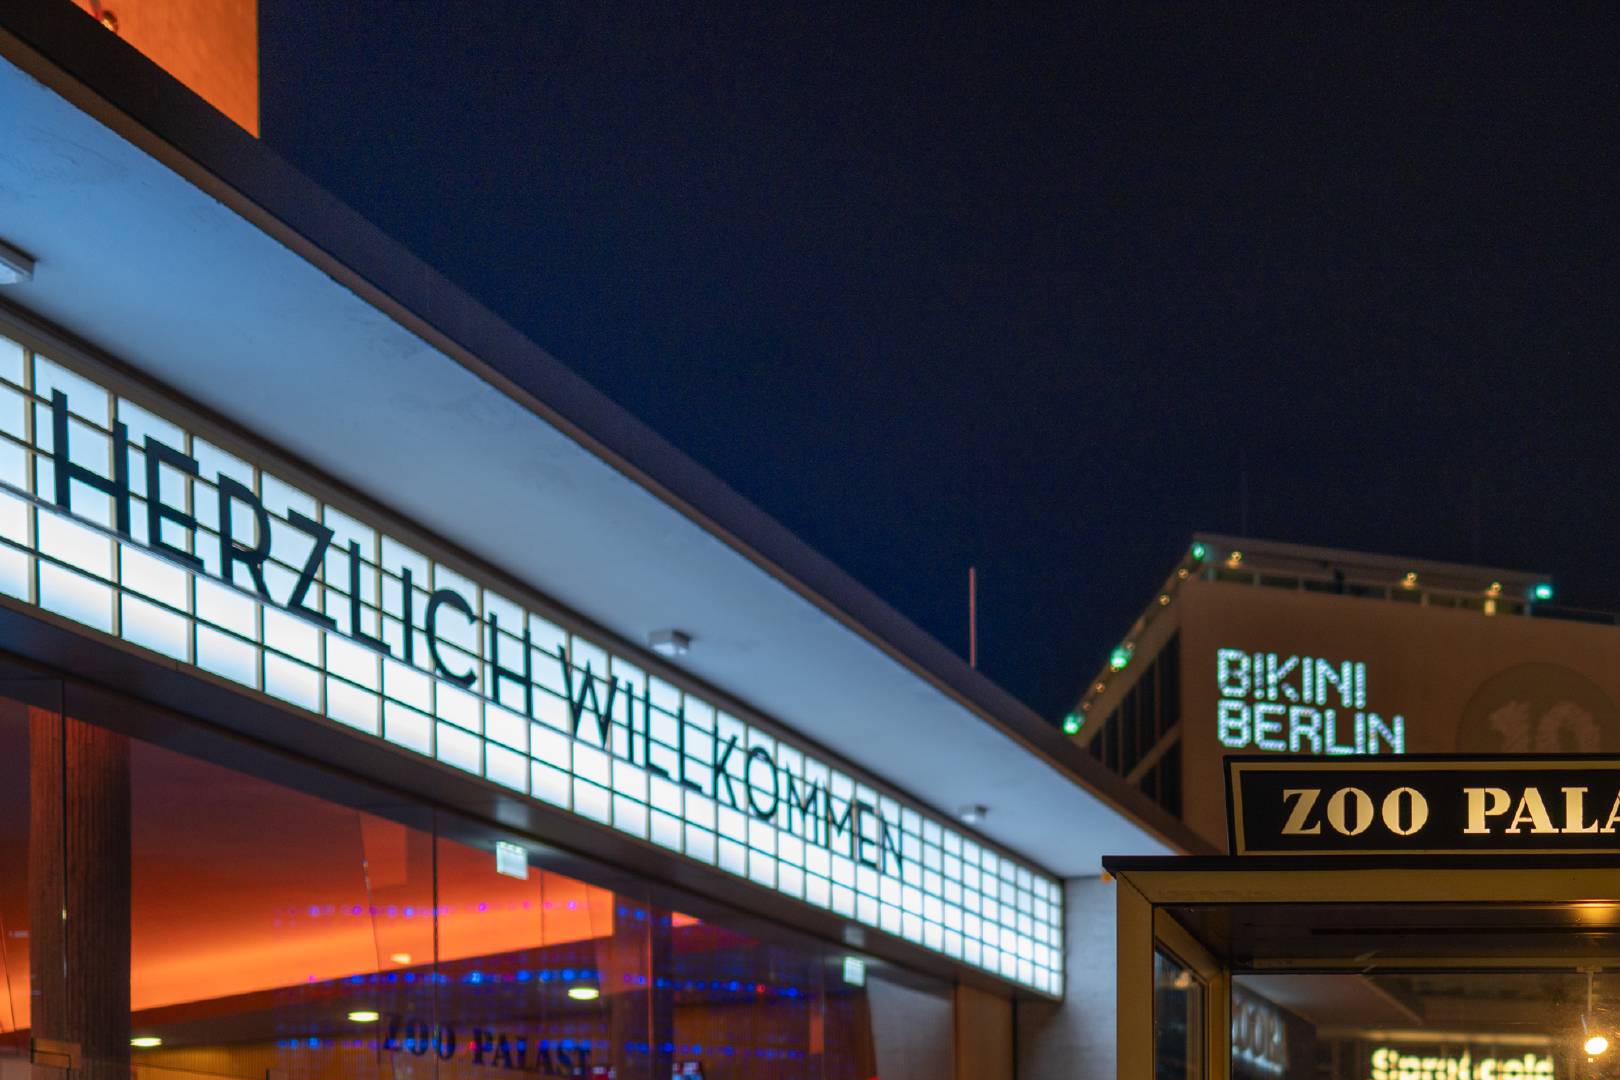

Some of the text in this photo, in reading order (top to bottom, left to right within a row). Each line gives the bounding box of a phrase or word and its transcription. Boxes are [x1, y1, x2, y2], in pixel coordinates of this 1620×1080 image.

[50, 388, 904, 877] HERZLICH WILLKOMMEN
[1217, 699, 1406, 755] BERLIN
[1281, 787, 1429, 836] ZOO
[383, 1016, 592, 1079] ZOO PALAST
